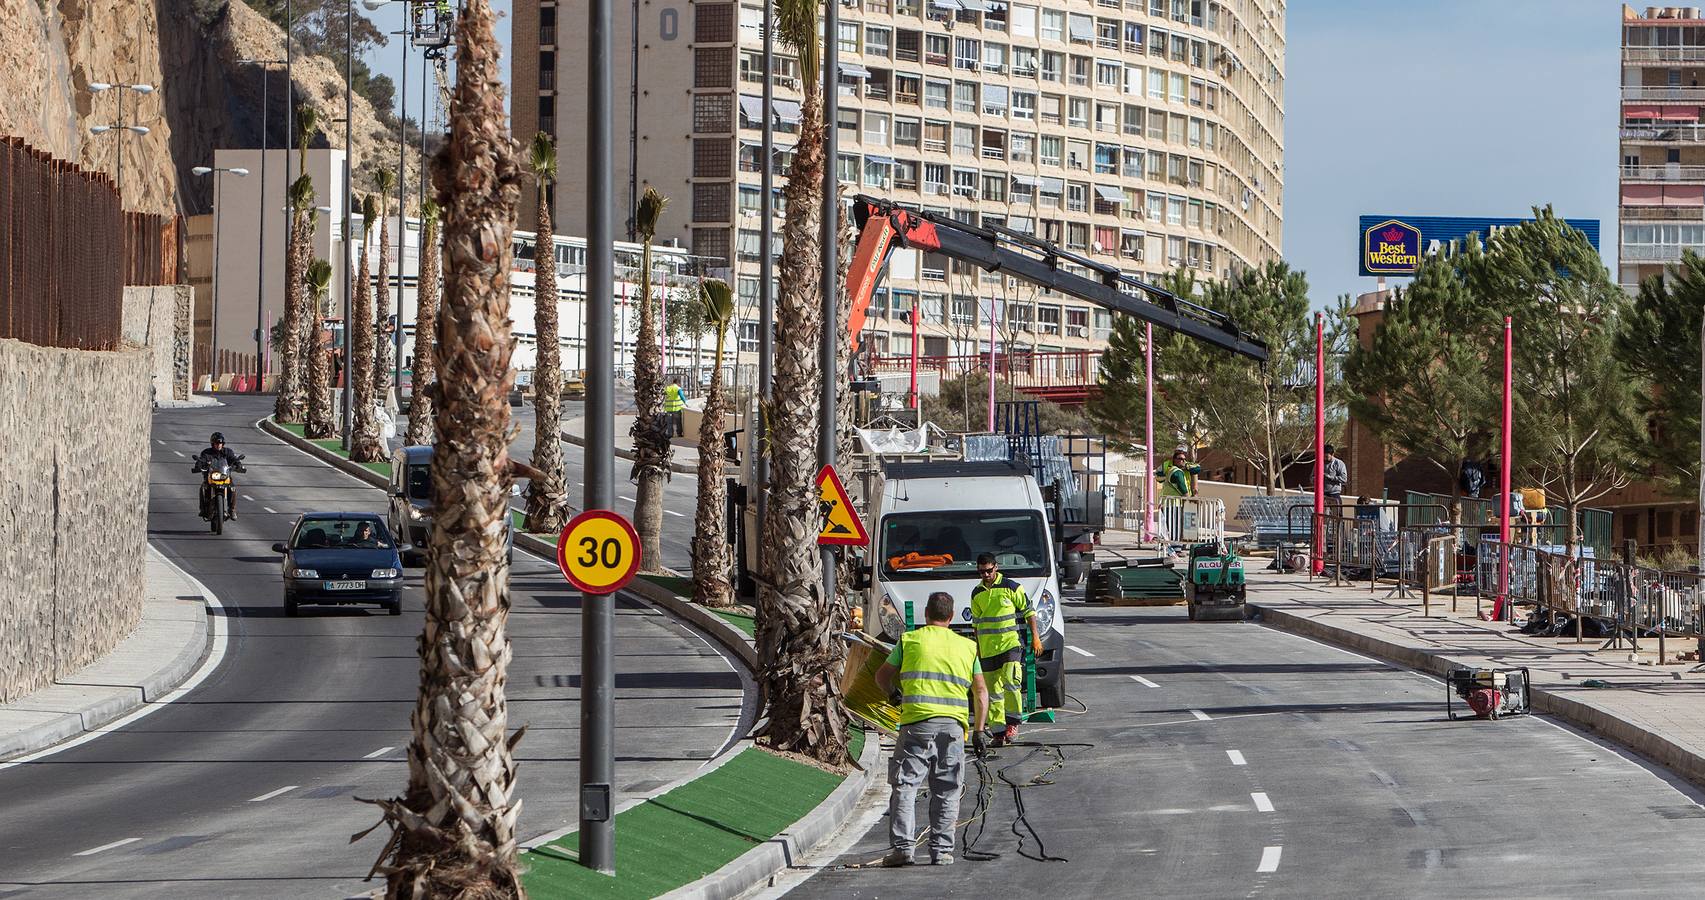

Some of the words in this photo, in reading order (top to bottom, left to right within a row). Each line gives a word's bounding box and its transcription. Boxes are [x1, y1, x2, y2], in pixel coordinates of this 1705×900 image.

[1379, 242, 1406, 254] Best
[1370, 252, 1417, 264] Western
[578, 536, 622, 569] 30
